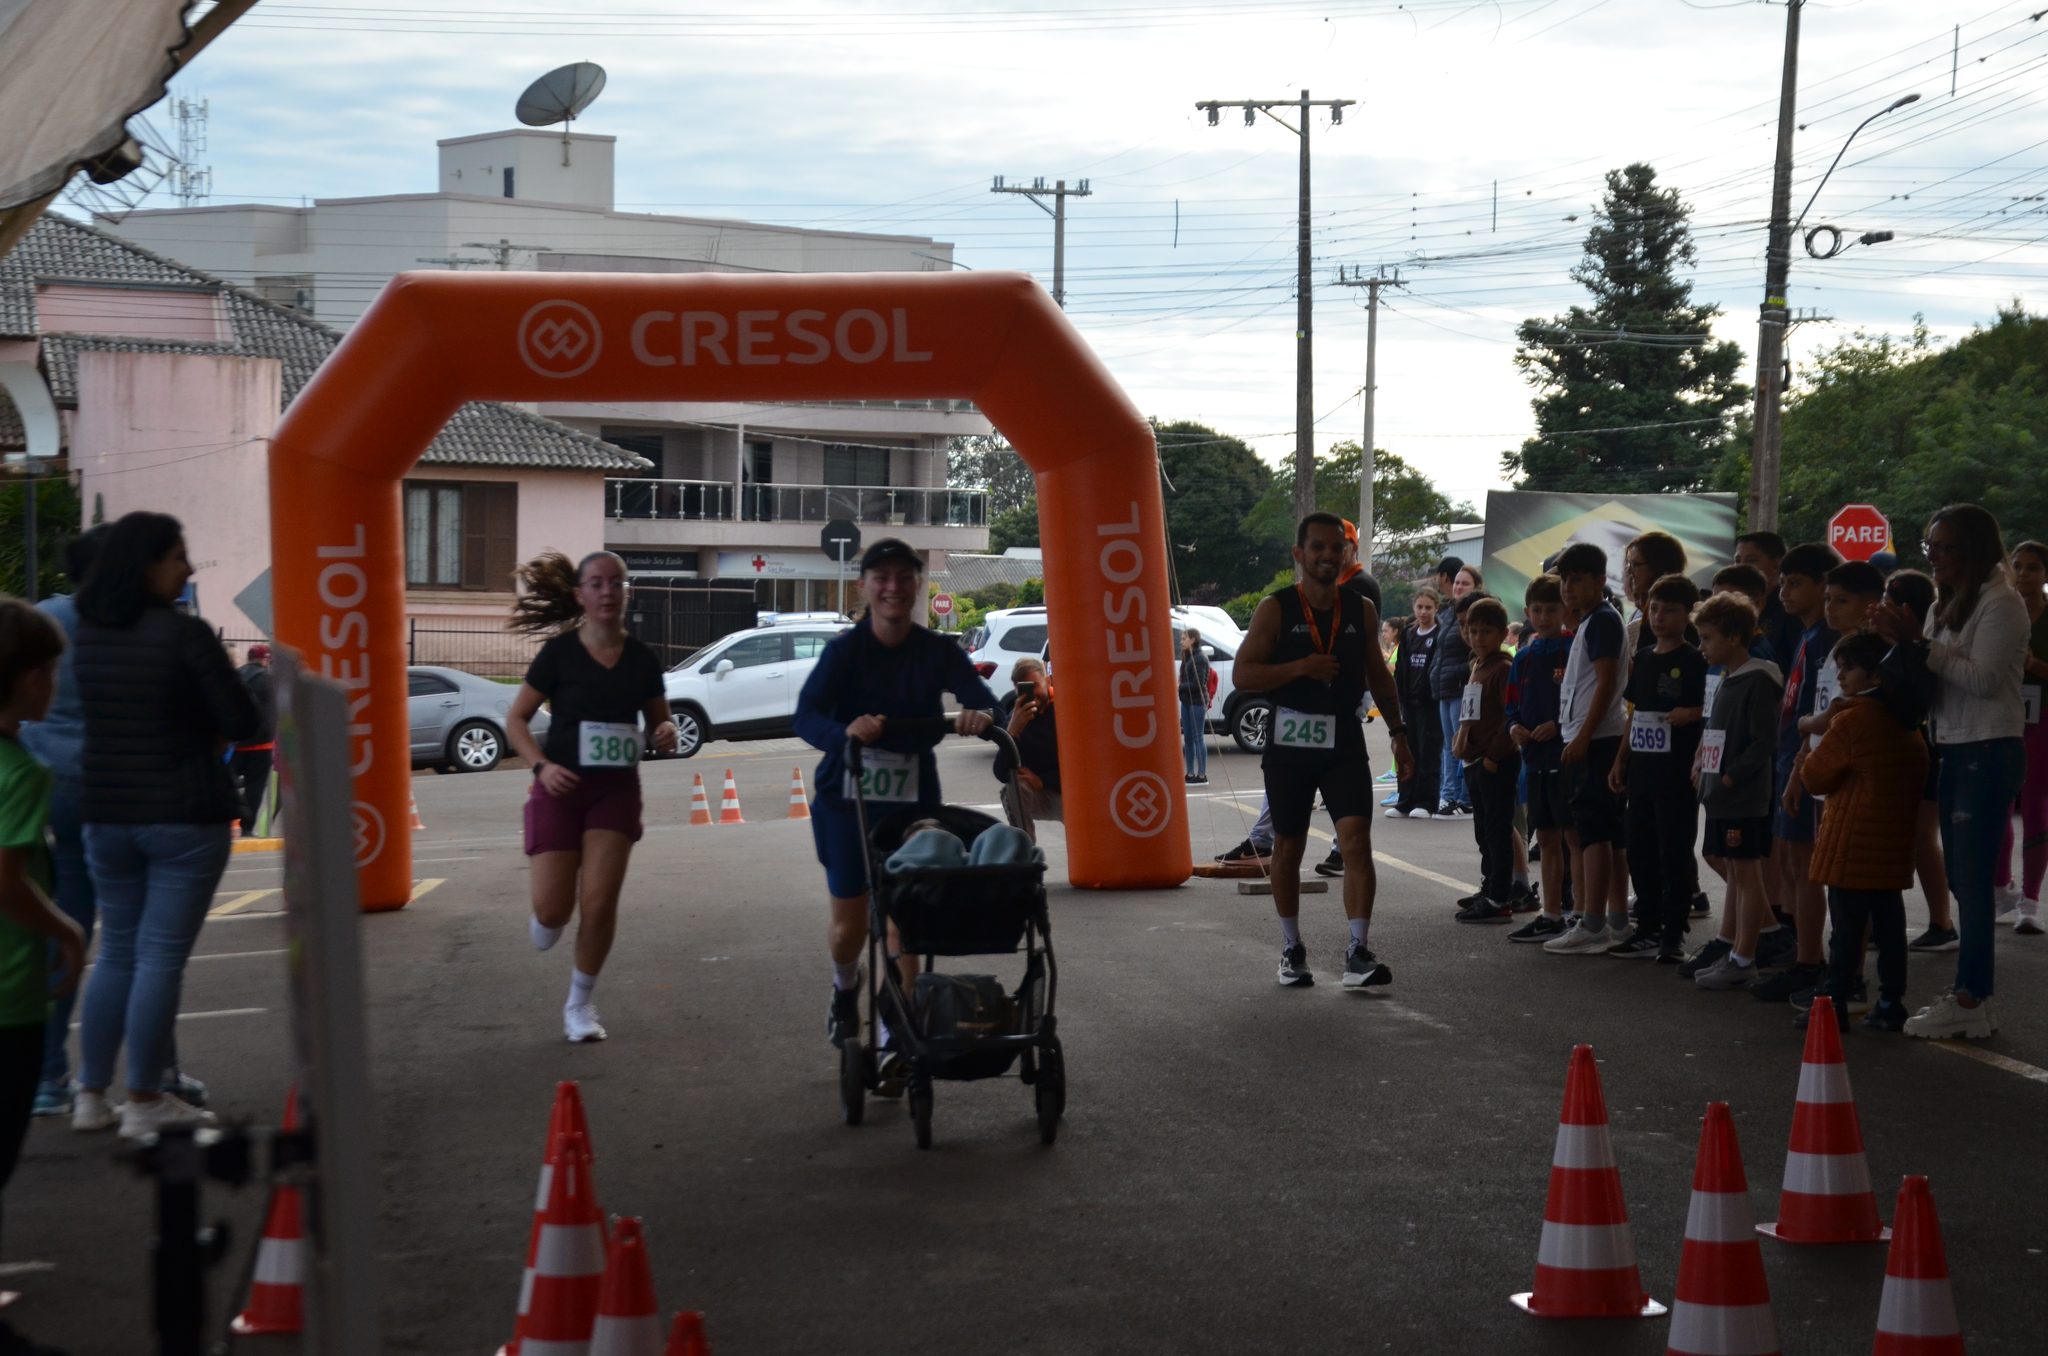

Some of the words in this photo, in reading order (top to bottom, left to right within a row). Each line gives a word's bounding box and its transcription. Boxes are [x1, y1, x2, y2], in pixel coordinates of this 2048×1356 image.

[630, 307, 934, 367] CRESOL
[1833, 525, 1885, 543] PARE
[935, 600, 950, 608] PARE
[1097, 500, 1157, 748] CRESOL
[1281, 719, 1327, 744] 245
[1631, 726, 1665, 749] 2569
[589, 735, 639, 762] 380
